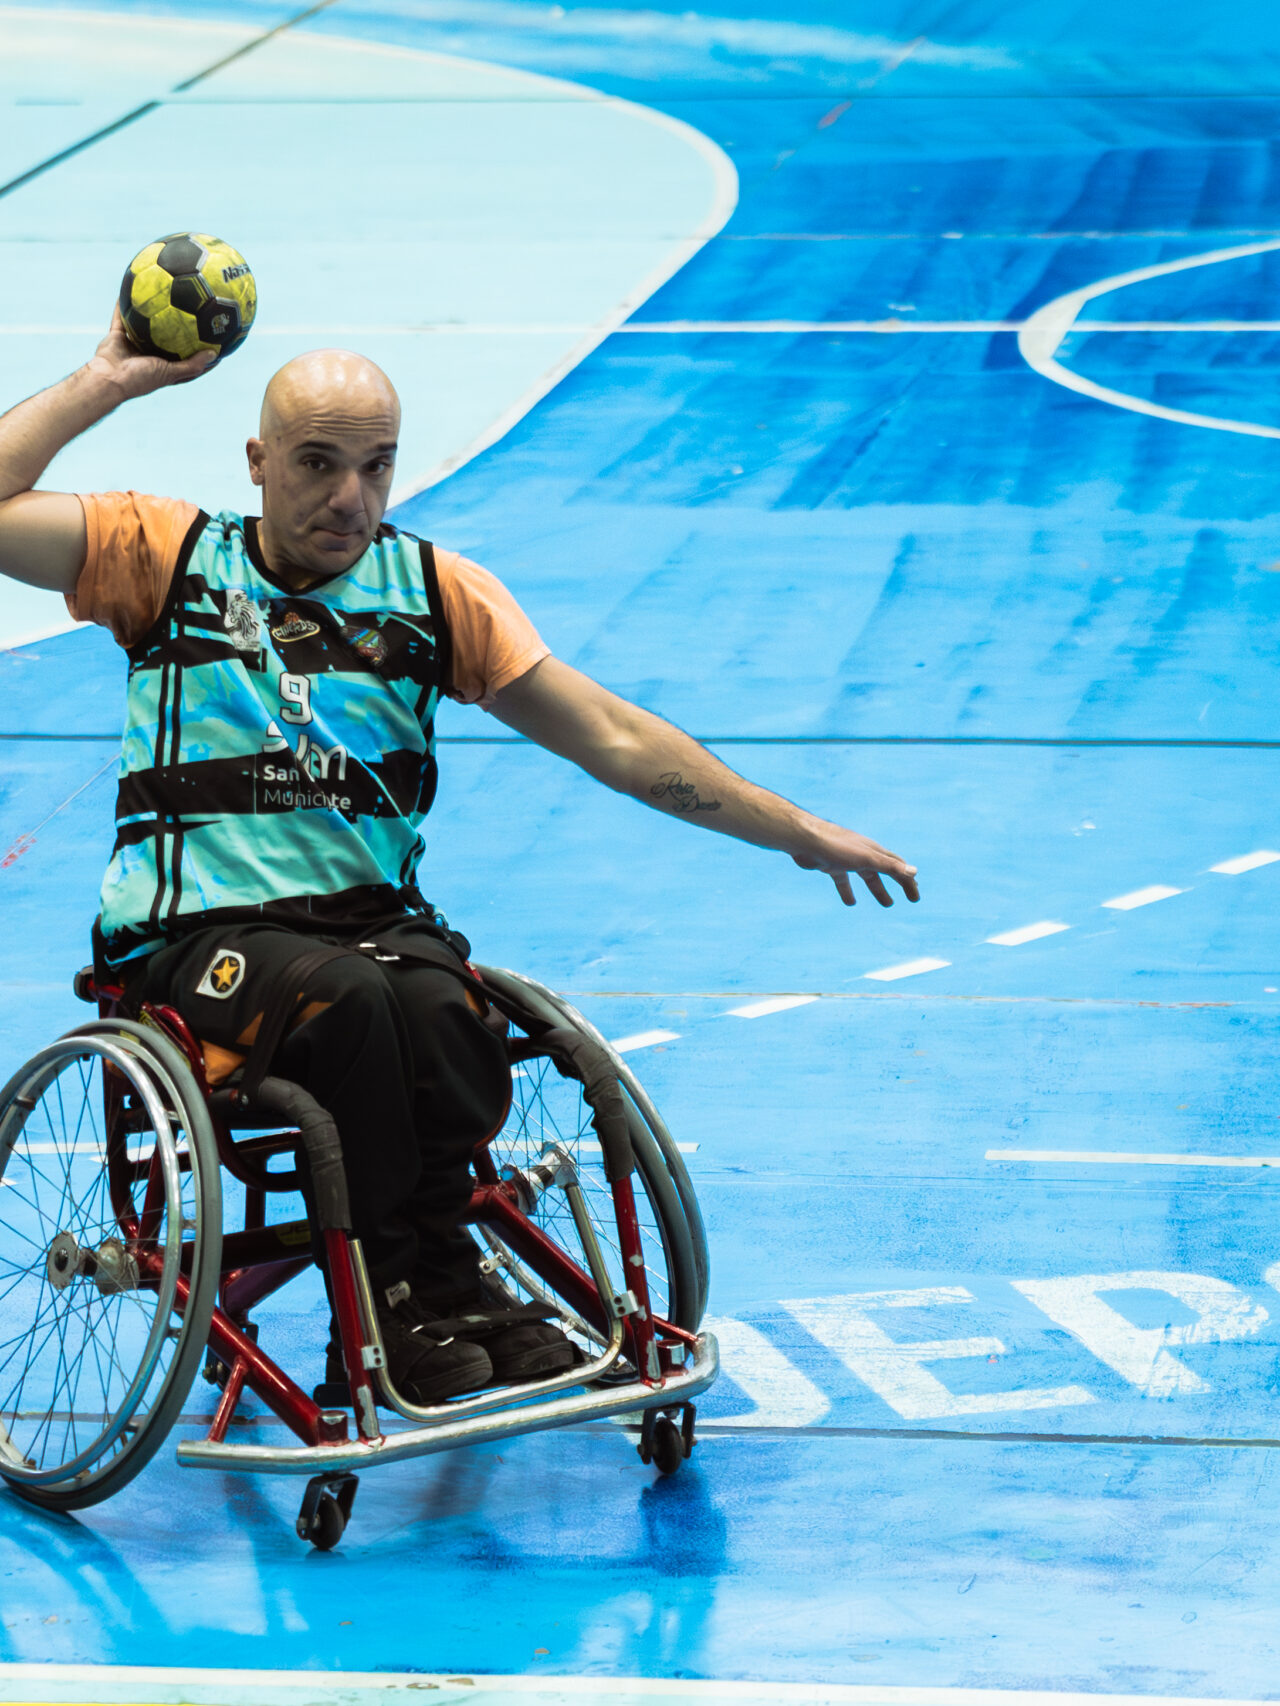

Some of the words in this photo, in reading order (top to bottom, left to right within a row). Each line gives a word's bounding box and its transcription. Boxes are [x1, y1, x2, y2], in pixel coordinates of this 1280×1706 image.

[279, 671, 313, 726] 9
[263, 764, 300, 781] San
[609, 1257, 1280, 1445] DEP
